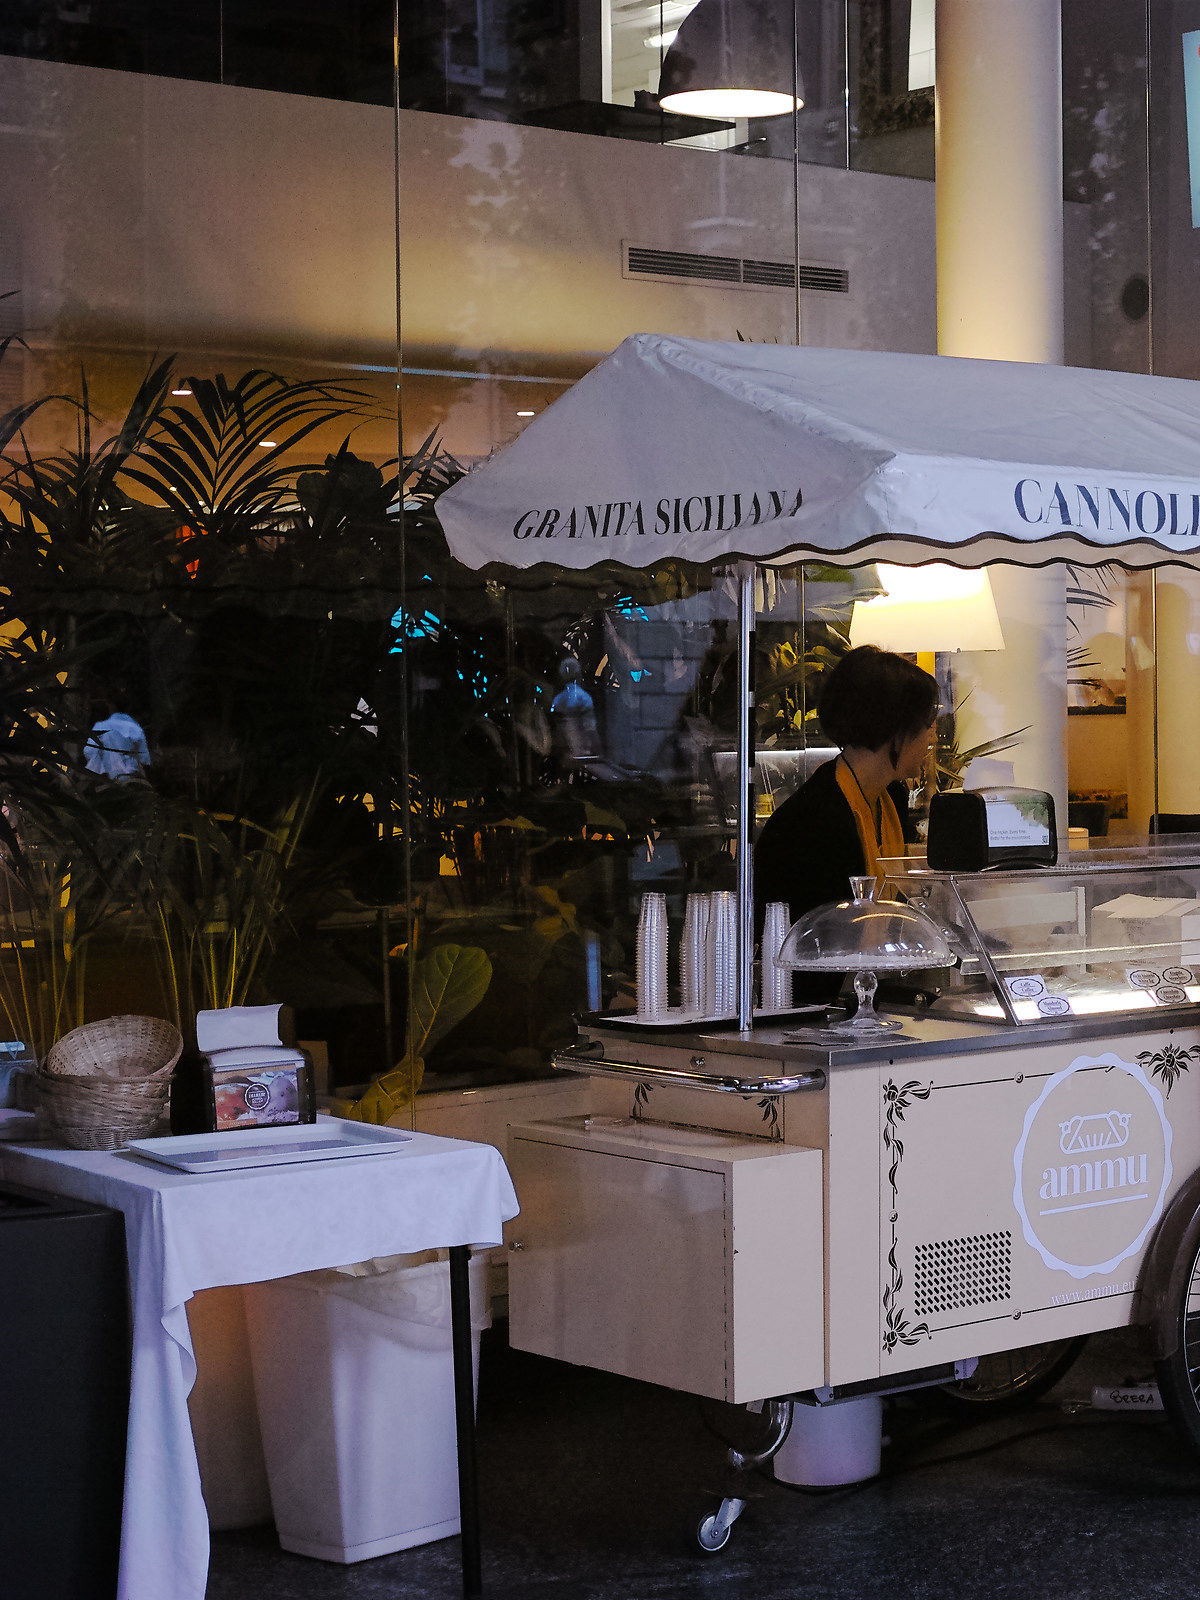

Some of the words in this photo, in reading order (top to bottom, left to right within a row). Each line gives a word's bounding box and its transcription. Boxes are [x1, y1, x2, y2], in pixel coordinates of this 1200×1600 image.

[512, 500, 646, 540] GRANITA
[654, 487, 803, 535] SICILIANA
[1014, 478, 1200, 537] CANNOLI
[1040, 1153, 1148, 1200] ammu
[1051, 1280, 1135, 1305] www.ammu.eu
[1110, 1389, 1154, 1404] BRERA
